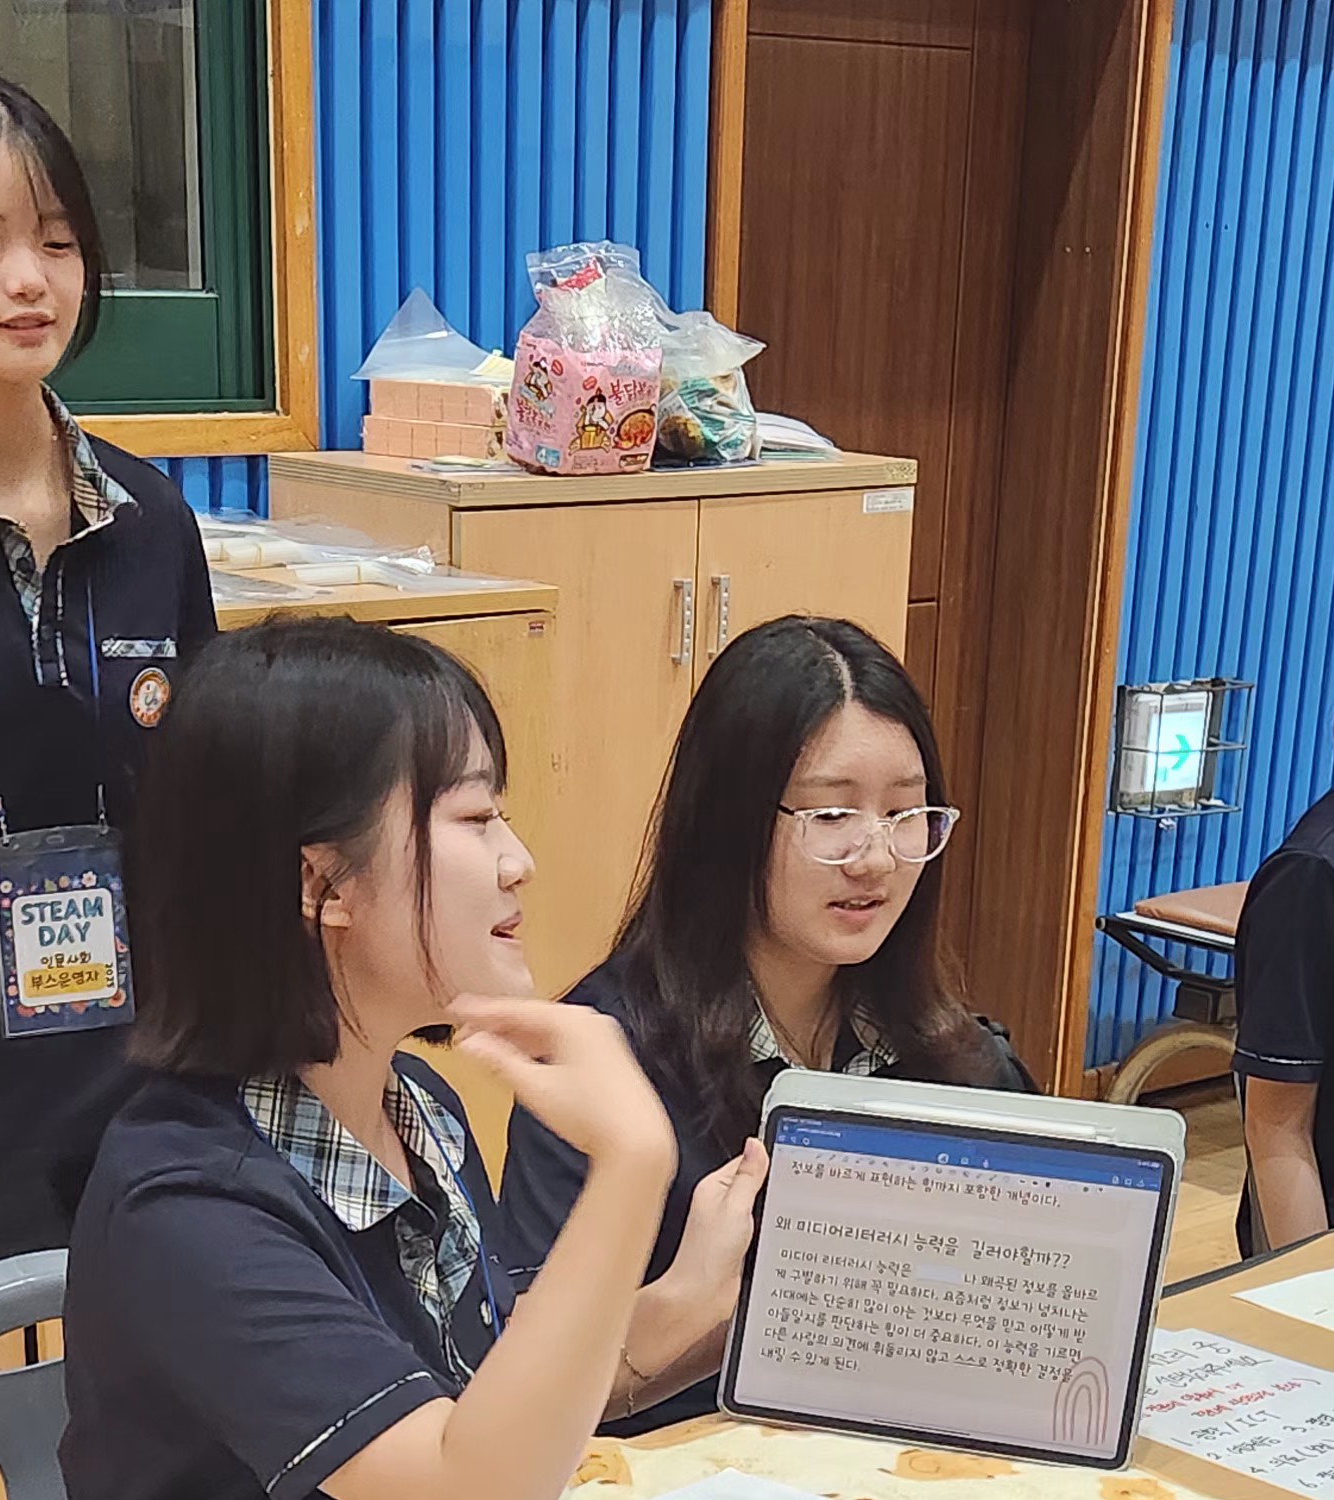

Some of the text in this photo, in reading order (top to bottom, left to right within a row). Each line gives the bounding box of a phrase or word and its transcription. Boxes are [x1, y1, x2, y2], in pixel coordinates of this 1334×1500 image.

[21, 896, 104, 926] STEAM
[38, 921, 91, 947] DAY
[31, 970, 100, 991] 부스운영자
[40, 951, 92, 969] 인문사회
[790, 1159, 1061, 1208] 정보를 바르게 표현하는 힘까지 포함한 개념이다.
[773, 1214, 1070, 1269] 왜 미디어리터러시 능력을 길러야할까??
[774, 1267, 787, 1279] 게
[788, 1268, 839, 1287] 구별하기
[841, 1275, 868, 1291] 위해
[870, 1278, 882, 1295] 꼭
[886, 1280, 939, 1301] 필요하다.
[942, 1289, 992, 1310] 요즘처럼
[995, 1295, 1033, 1314] 정보가
[875, 1259, 912, 1278] 능력은
[979, 1274, 1018, 1293] 왜곡된
[1021, 1278, 1058, 1299] 정보를
[1060, 1283, 1098, 1301] 올바르
[769, 1287, 819, 1306] 시대에는
[822, 1292, 859, 1311] 단순히
[862, 1297, 889, 1315] 많이
[891, 1303, 917, 1320] 아는
[921, 1305, 957, 1323] 것보다
[960, 1312, 997, 1331] 무엇을
[1001, 1316, 1026, 1334] 믿고
[1072, 1327, 1086, 1344] 받
[830, 1313, 880, 1335] 판단하는
[883, 1320, 910, 1338] 힘이
[912, 1327, 926, 1340] 더
[928, 1327, 982, 1349] 중요하다.
[985, 1337, 1000, 1350] 이
[1002, 1338, 1039, 1358] 능력을
[759, 1345, 861, 1372] 내릴 수 있게 된다.
[763, 1325, 788, 1342] 다른
[790, 1330, 829, 1347] 사람의
[830, 1335, 869, 1352] 의견에
[924, 1347, 950, 1364] 않고
[952, 1352, 988, 1368] 스스로
[991, 1356, 1031, 1378] 정확한
